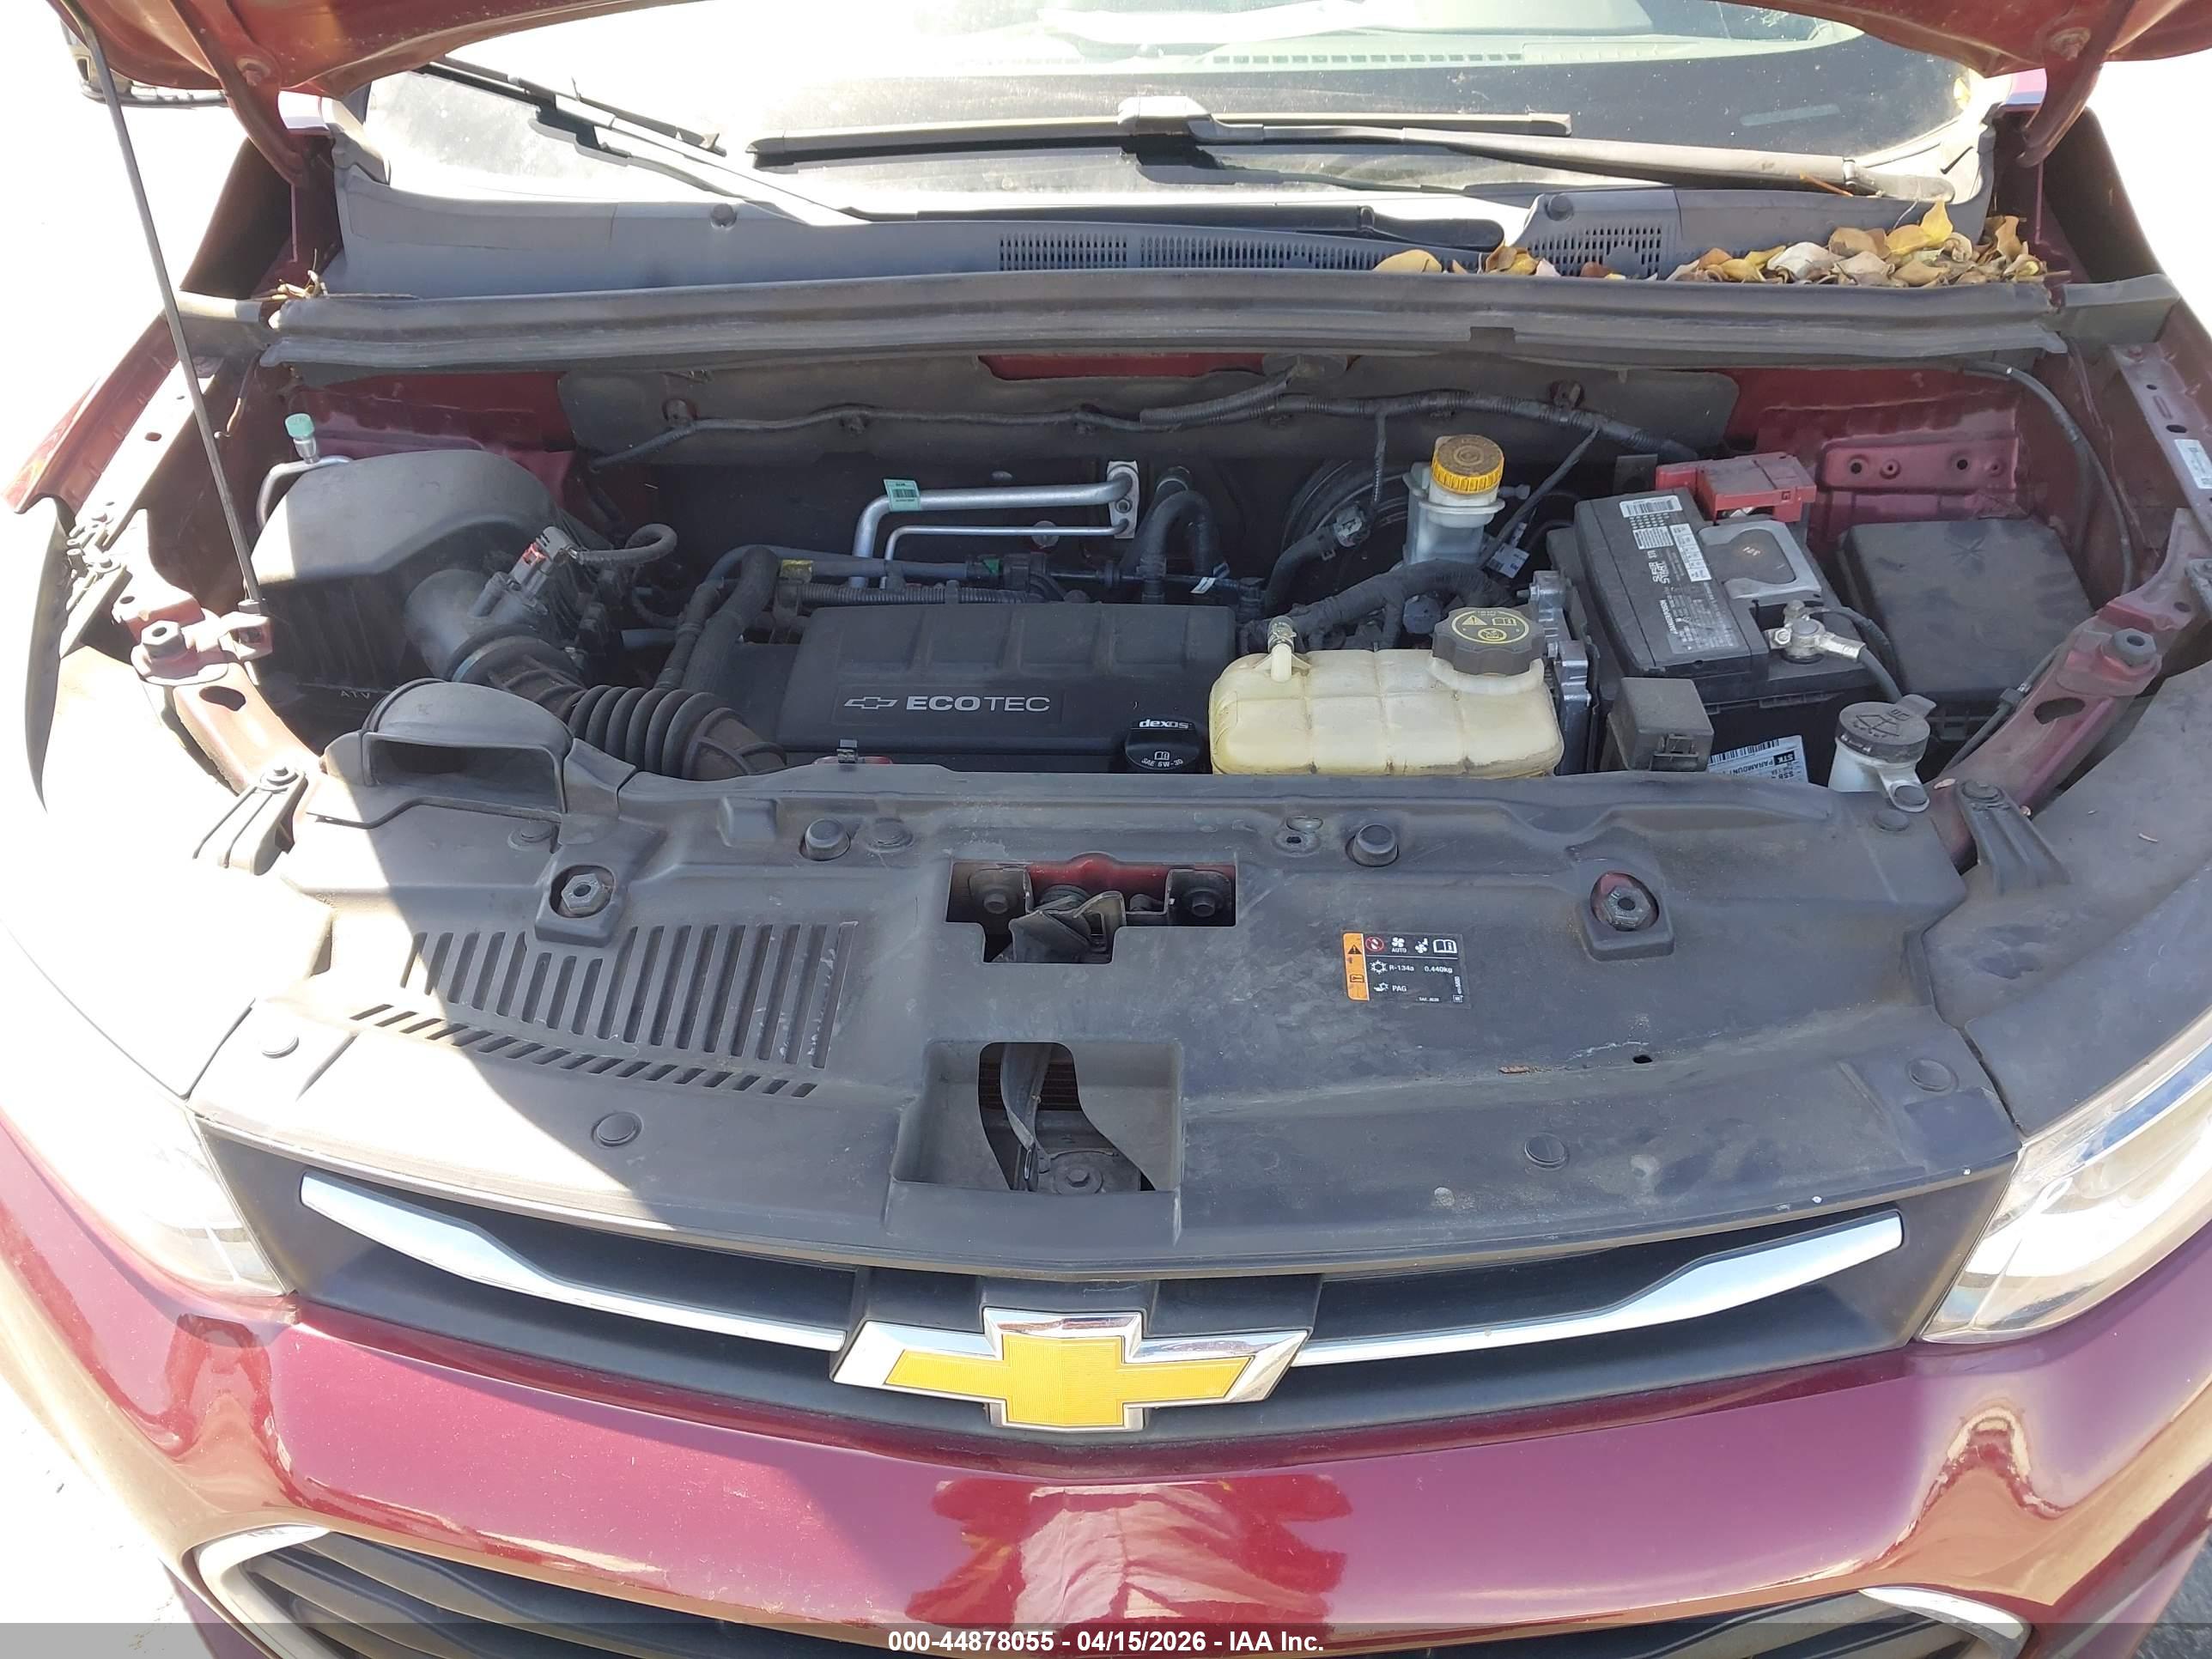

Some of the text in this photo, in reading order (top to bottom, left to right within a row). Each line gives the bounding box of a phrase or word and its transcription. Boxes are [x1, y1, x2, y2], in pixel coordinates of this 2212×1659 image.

[906, 696, 1050, 712] ECOTEC
[1139, 719, 1189, 729] dexos
[1141, 757, 1155, 767] SAE
[1777, 754, 1794, 763] STK
[1424, 965, 1454, 974] 0.440kg
